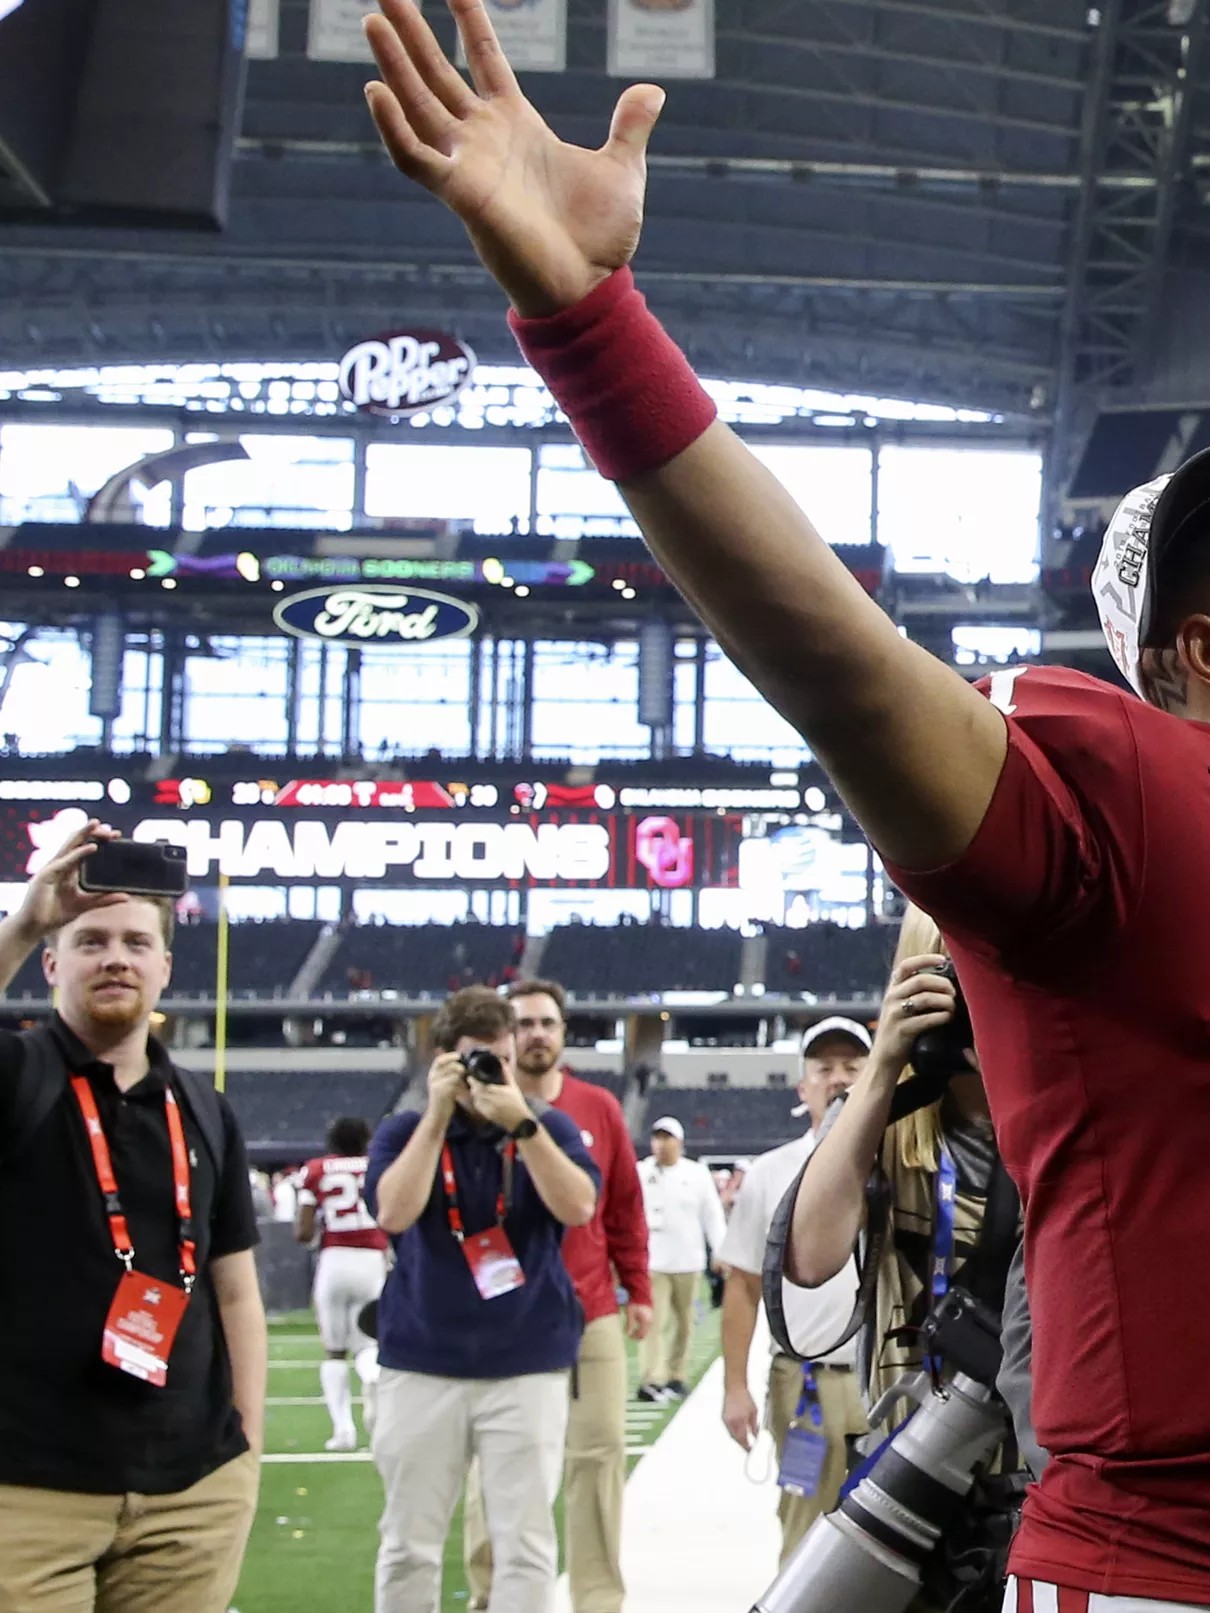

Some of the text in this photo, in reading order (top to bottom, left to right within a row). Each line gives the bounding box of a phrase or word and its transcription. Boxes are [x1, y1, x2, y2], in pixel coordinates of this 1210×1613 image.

[339, 340, 469, 408] Pepper
[388, 335, 440, 370] Dr
[1118, 496, 1158, 588] CHAM
[314, 592, 439, 639] Ford
